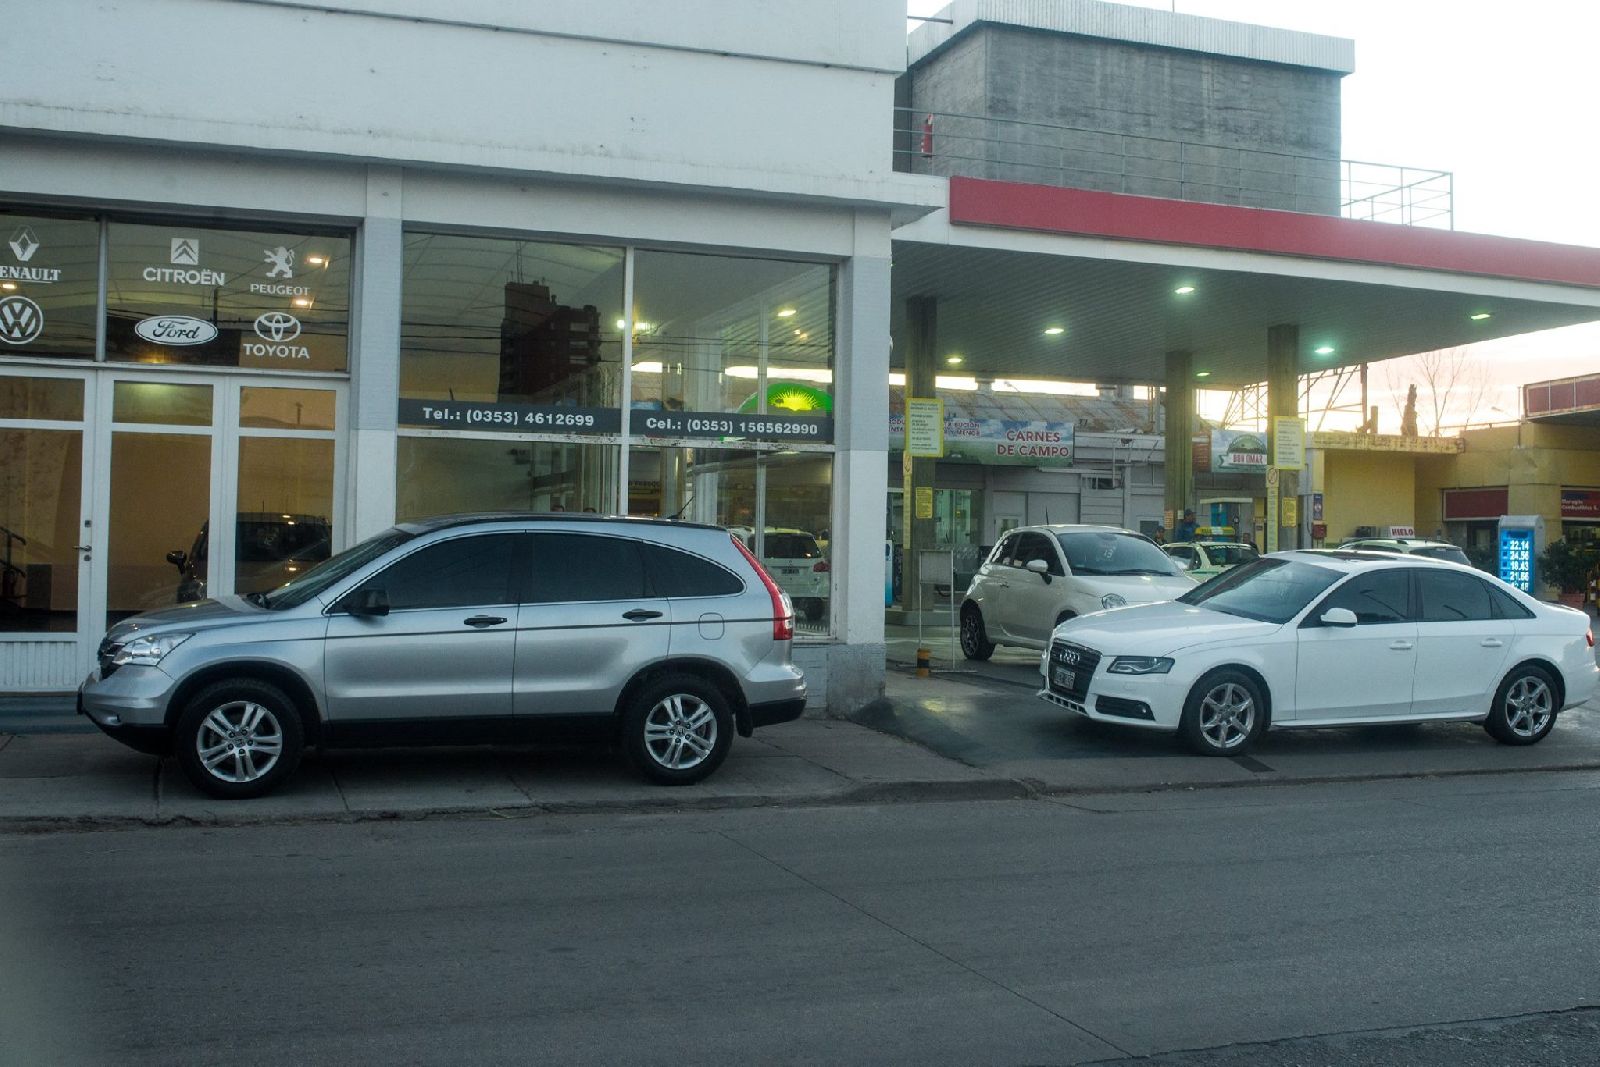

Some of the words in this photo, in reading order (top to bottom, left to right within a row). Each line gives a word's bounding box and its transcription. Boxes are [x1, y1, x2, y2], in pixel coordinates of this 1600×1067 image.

[0, 265, 61, 281] ENAULT
[143, 267, 225, 286] CITROËN
[250, 283, 310, 296] PEUGEOT
[152, 320, 201, 340] Ford
[243, 343, 310, 359] TOYOTA
[423, 407, 461, 420] Tel.:
[466, 409, 518, 425] (0353)
[525, 412, 594, 426] 4612699
[646, 418, 682, 430] Cel.:
[687, 418, 733, 433] (0353)
[739, 421, 818, 434] 156562990
[1006, 430, 1060, 442] CARNES
[997, 444, 1015, 455] DE
[1019, 445, 1069, 457] CAMPO
[1391, 528, 1414, 536] HIELO
